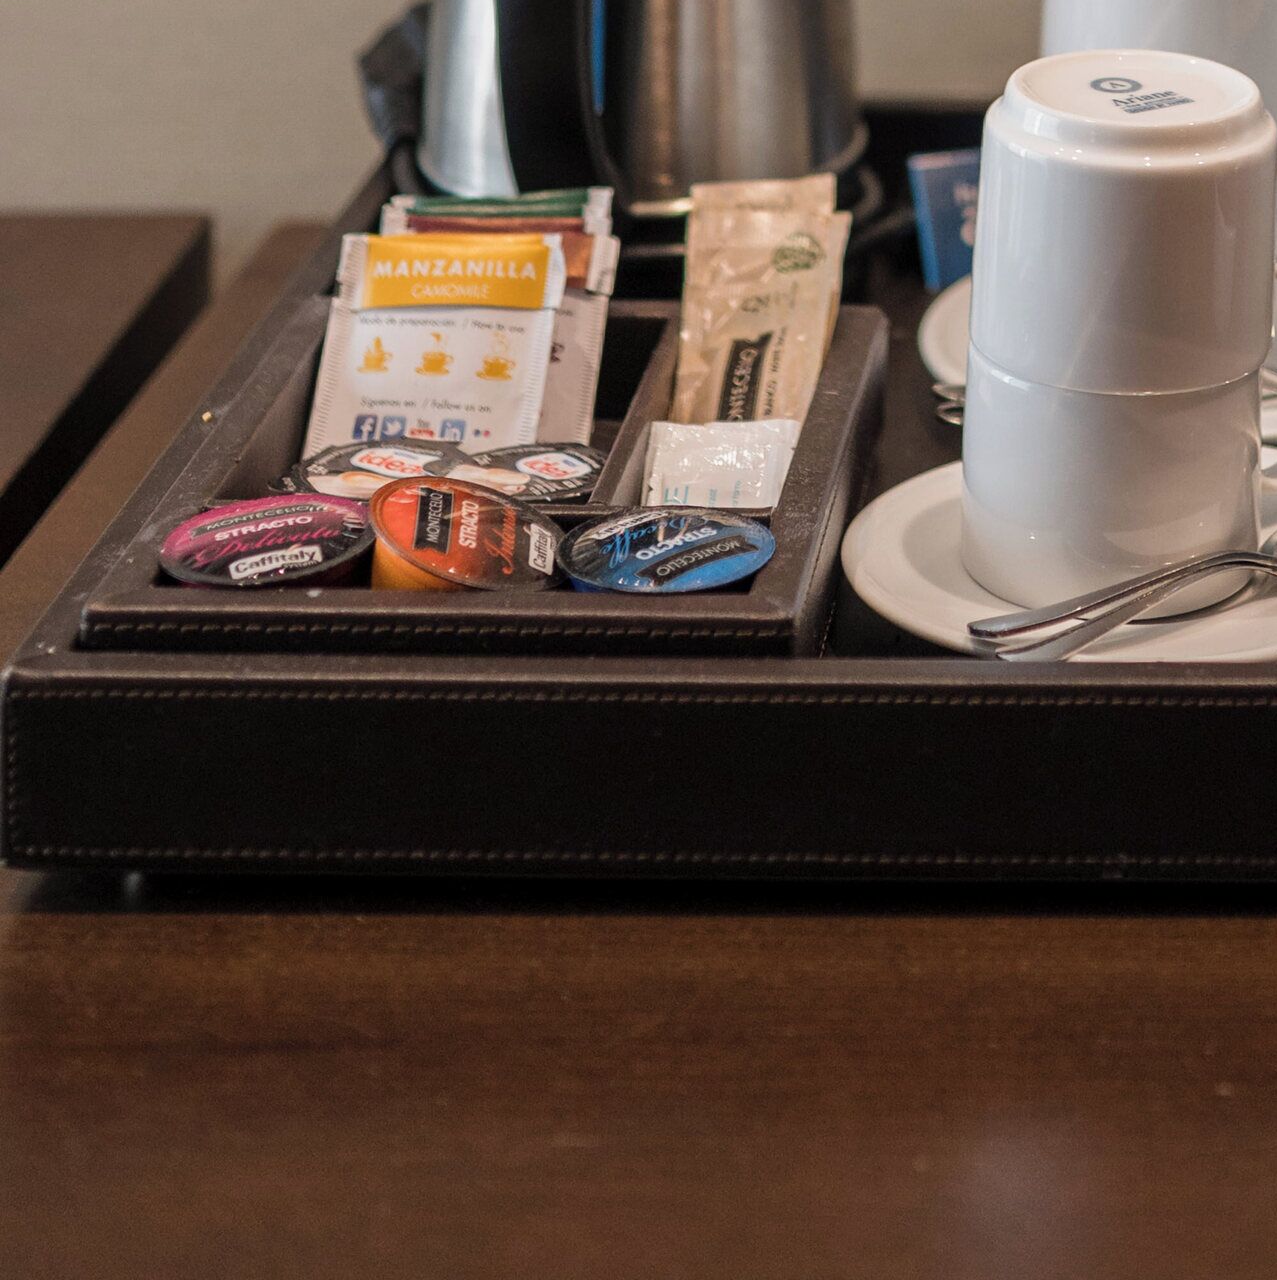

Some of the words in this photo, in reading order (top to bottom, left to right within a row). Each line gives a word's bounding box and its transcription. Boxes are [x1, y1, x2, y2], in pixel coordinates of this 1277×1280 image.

[1112, 90, 1176, 107] Ariane
[371, 258, 537, 281] MANZANILLA
[410, 283, 491, 300] CAMOMILE
[214, 515, 314, 542] STRACTO
[425, 492, 444, 543] MONTECELIO
[458, 500, 480, 549] STRACTO
[635, 526, 718, 561] STRACTO
[234, 547, 318, 574] Caffitaly
[656, 540, 740, 577] MONTECELIO
